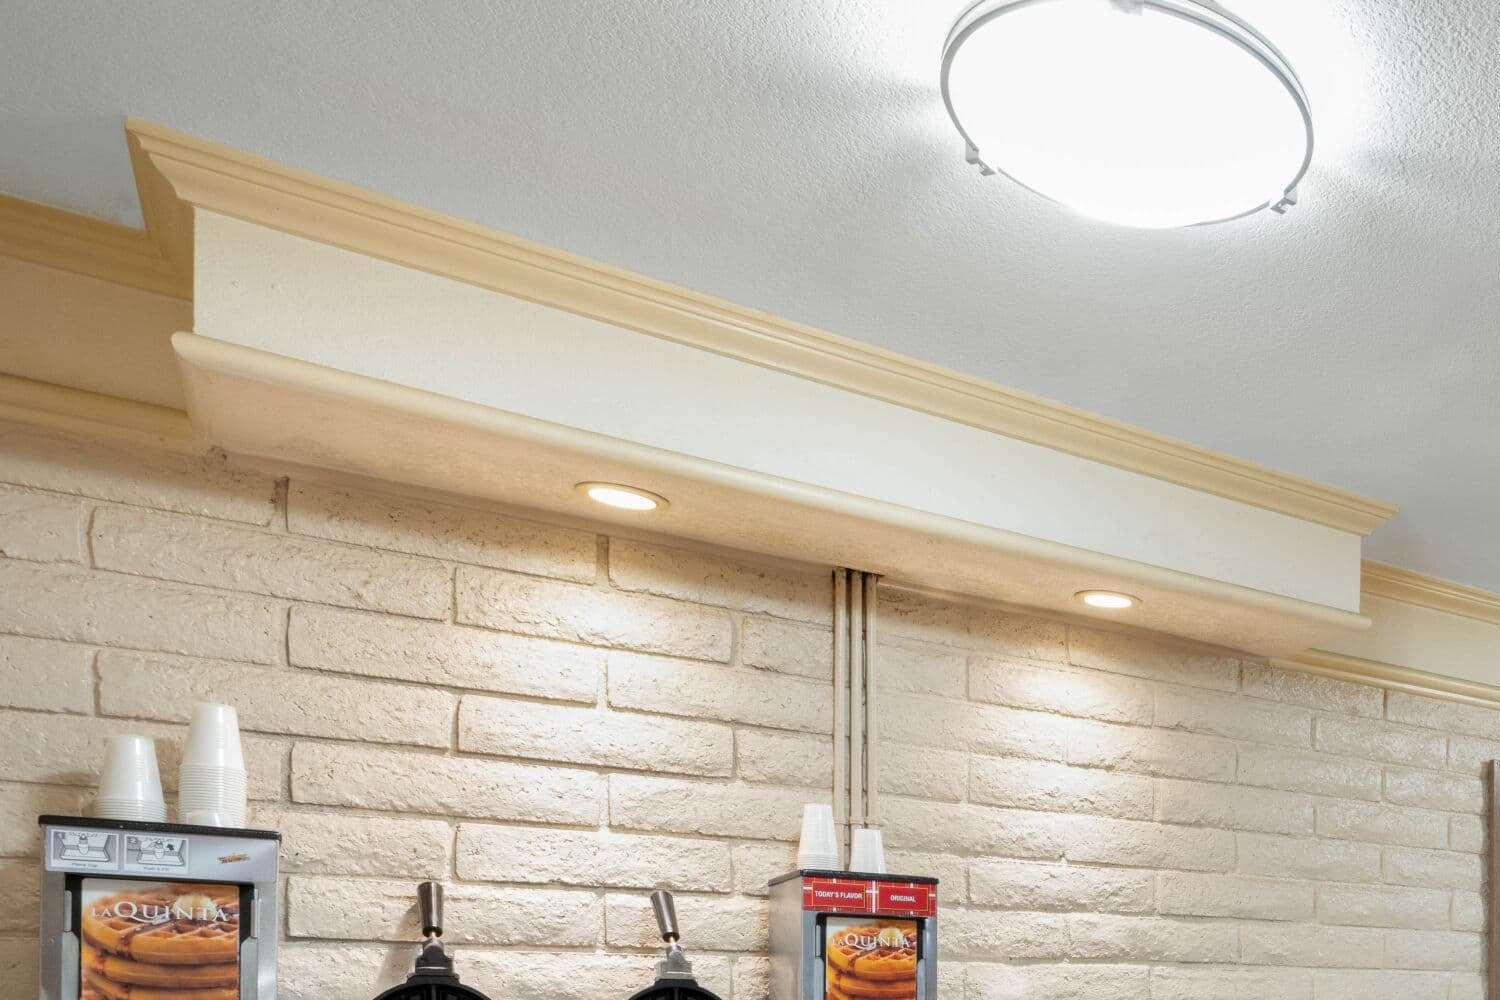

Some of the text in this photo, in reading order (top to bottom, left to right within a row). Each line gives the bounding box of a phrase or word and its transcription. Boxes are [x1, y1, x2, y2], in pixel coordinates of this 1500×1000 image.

[815, 890, 863, 900] TODAY'S FLAVOR
[889, 894, 916, 903] ORIGINAL
[92, 901, 230, 924] LA QUINTA
[844, 933, 911, 951] QUINTA
